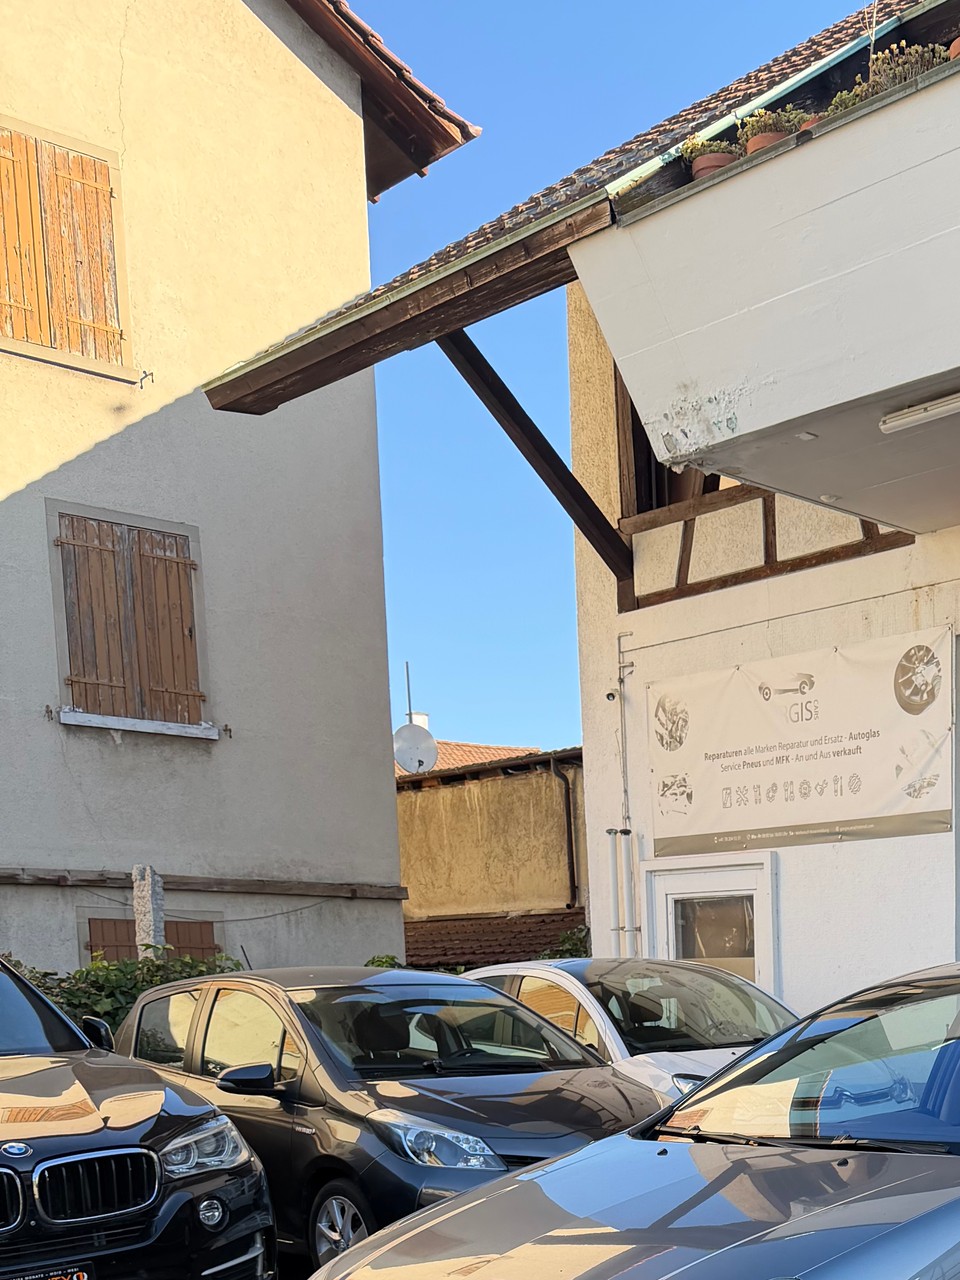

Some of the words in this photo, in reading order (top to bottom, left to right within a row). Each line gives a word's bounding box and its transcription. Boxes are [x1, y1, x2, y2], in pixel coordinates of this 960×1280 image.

[704, 750, 743, 762] Reparaturen
[743, 746, 755, 756] alle
[755, 743, 777, 755] Marken
[778, 740, 809, 752] Reparatur
[810, 736, 823, 747] und
[824, 734, 843, 745] Ersatz
[848, 729, 880, 741] Autoglas
[720, 762, 742, 772] Service
[742, 760, 761, 770] Pneus
[762, 758, 774, 767] und
[775, 755, 790, 765] MFK
[795, 754, 804, 762] An
[804, 751, 818, 761] und
[819, 750, 831, 759] Aus
[832, 745, 862, 757] verkauft
